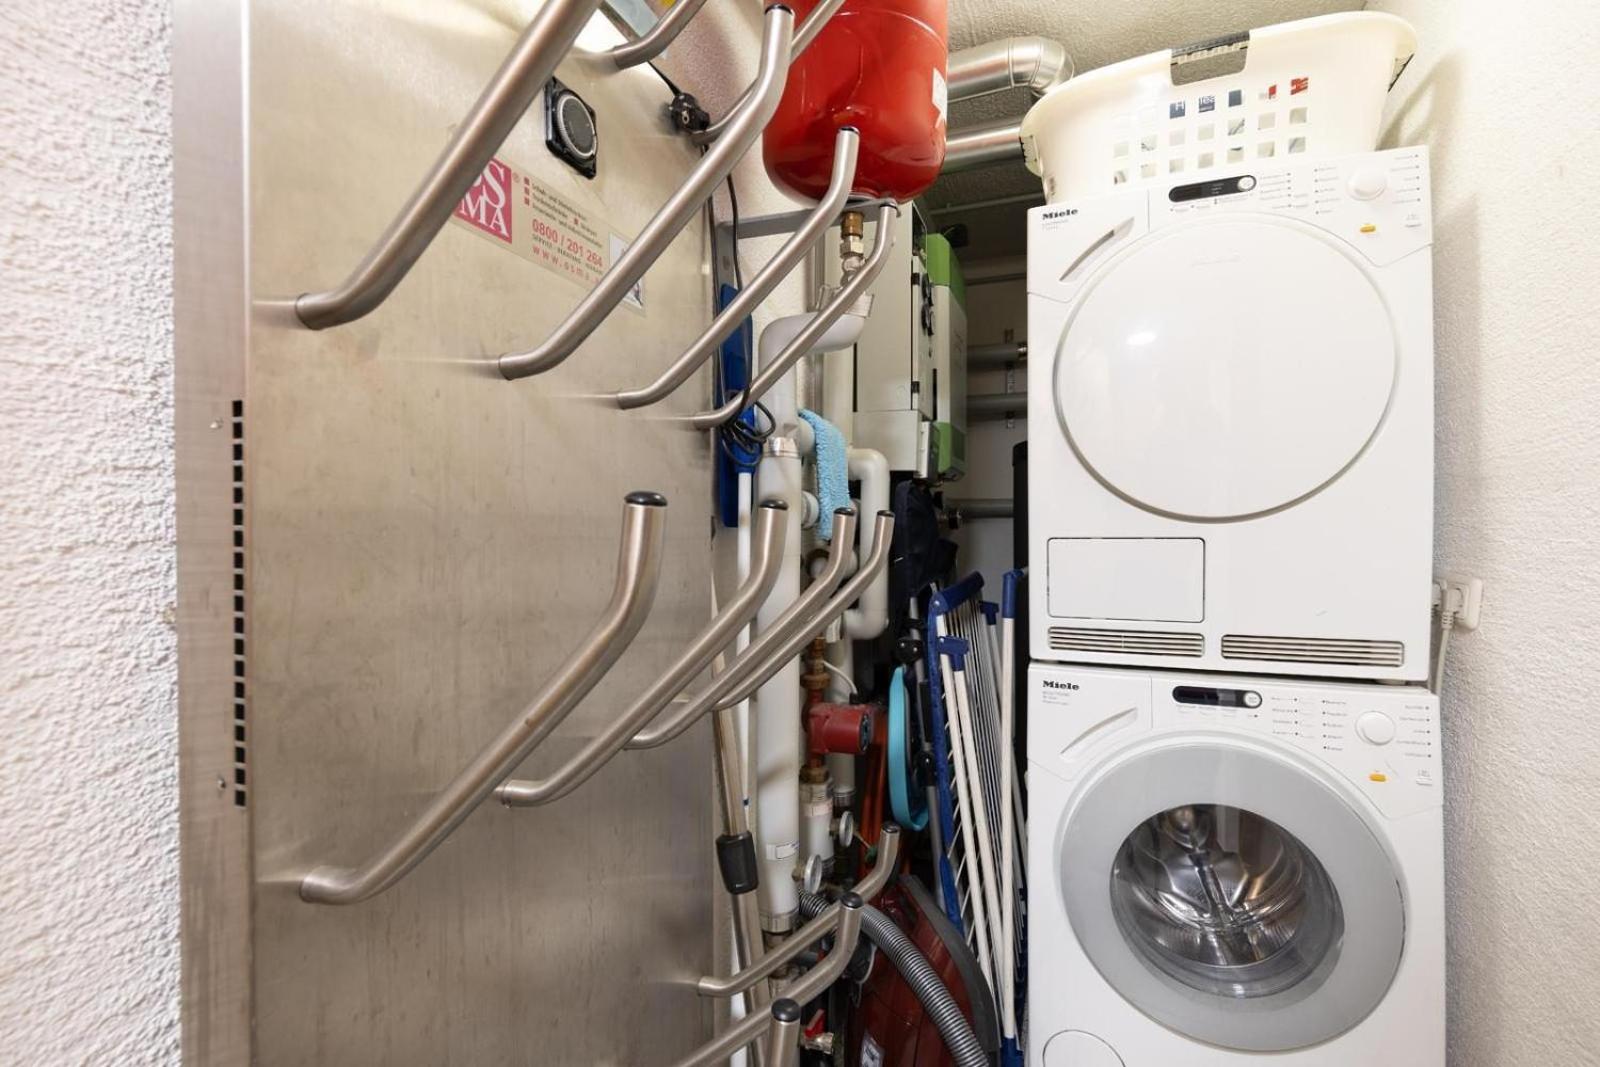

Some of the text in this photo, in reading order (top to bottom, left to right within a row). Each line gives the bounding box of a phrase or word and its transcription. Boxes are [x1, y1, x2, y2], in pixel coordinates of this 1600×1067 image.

[1042, 208, 1079, 221] Miele
[532, 218, 558, 243] 0800
[566, 237, 583, 258] 201
[1042, 680, 1080, 691] Miele
